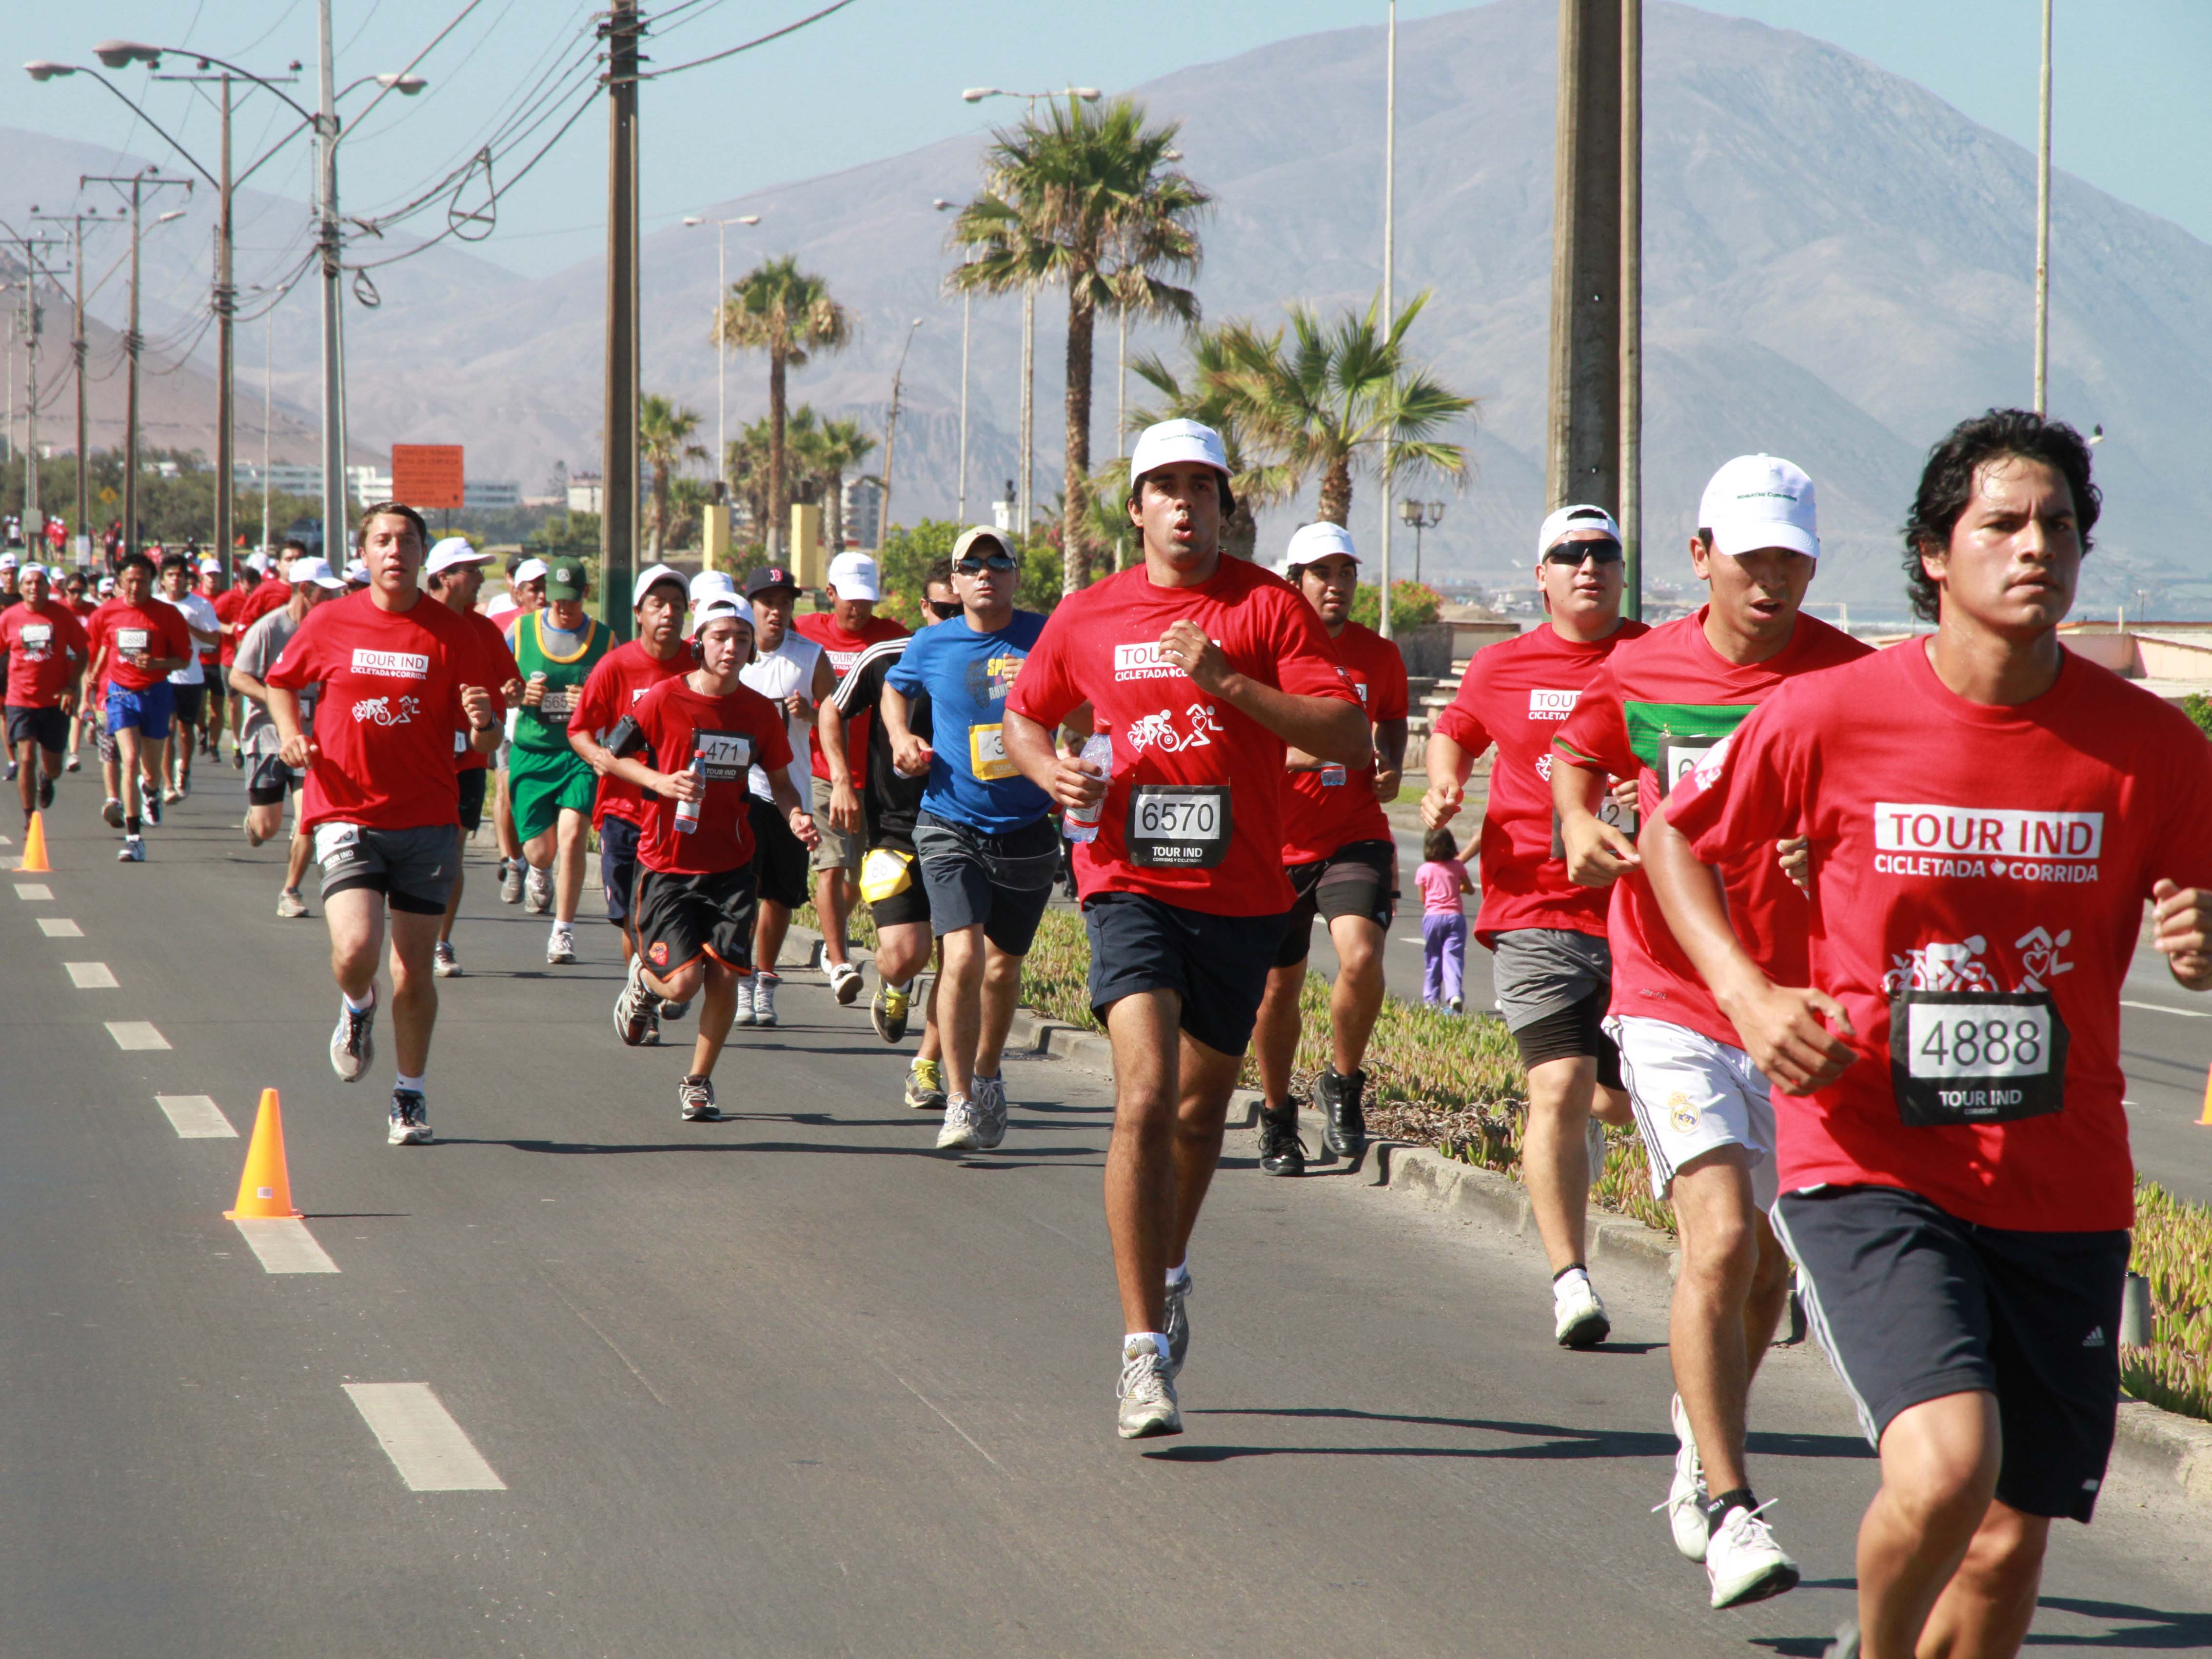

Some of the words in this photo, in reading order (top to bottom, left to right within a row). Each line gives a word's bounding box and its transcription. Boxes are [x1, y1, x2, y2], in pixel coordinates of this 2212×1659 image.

[359, 652, 396, 667] TOUR
[401, 656, 424, 669] IND
[1122, 647, 1161, 665] TOU
[351, 666, 390, 677] CICLETADA
[396, 671, 426, 680] CORRIDA
[1115, 668, 1168, 682] CICLETADA
[707, 742, 738, 761] 471
[1142, 802, 1214, 832] 6570
[1889, 813, 2003, 851] TOUR
[2020, 819, 2094, 855] IND
[1152, 847, 1181, 857] TOUR
[1183, 848, 1203, 858] IND
[872, 861, 887, 878] 88
[1874, 854, 1986, 877] CICLETADA
[2009, 861, 2099, 883] CORRIDA
[1921, 1019, 2040, 1066] 4888
[1938, 1090, 1986, 1107] TOUR
[1990, 1089, 2023, 1105] IND
